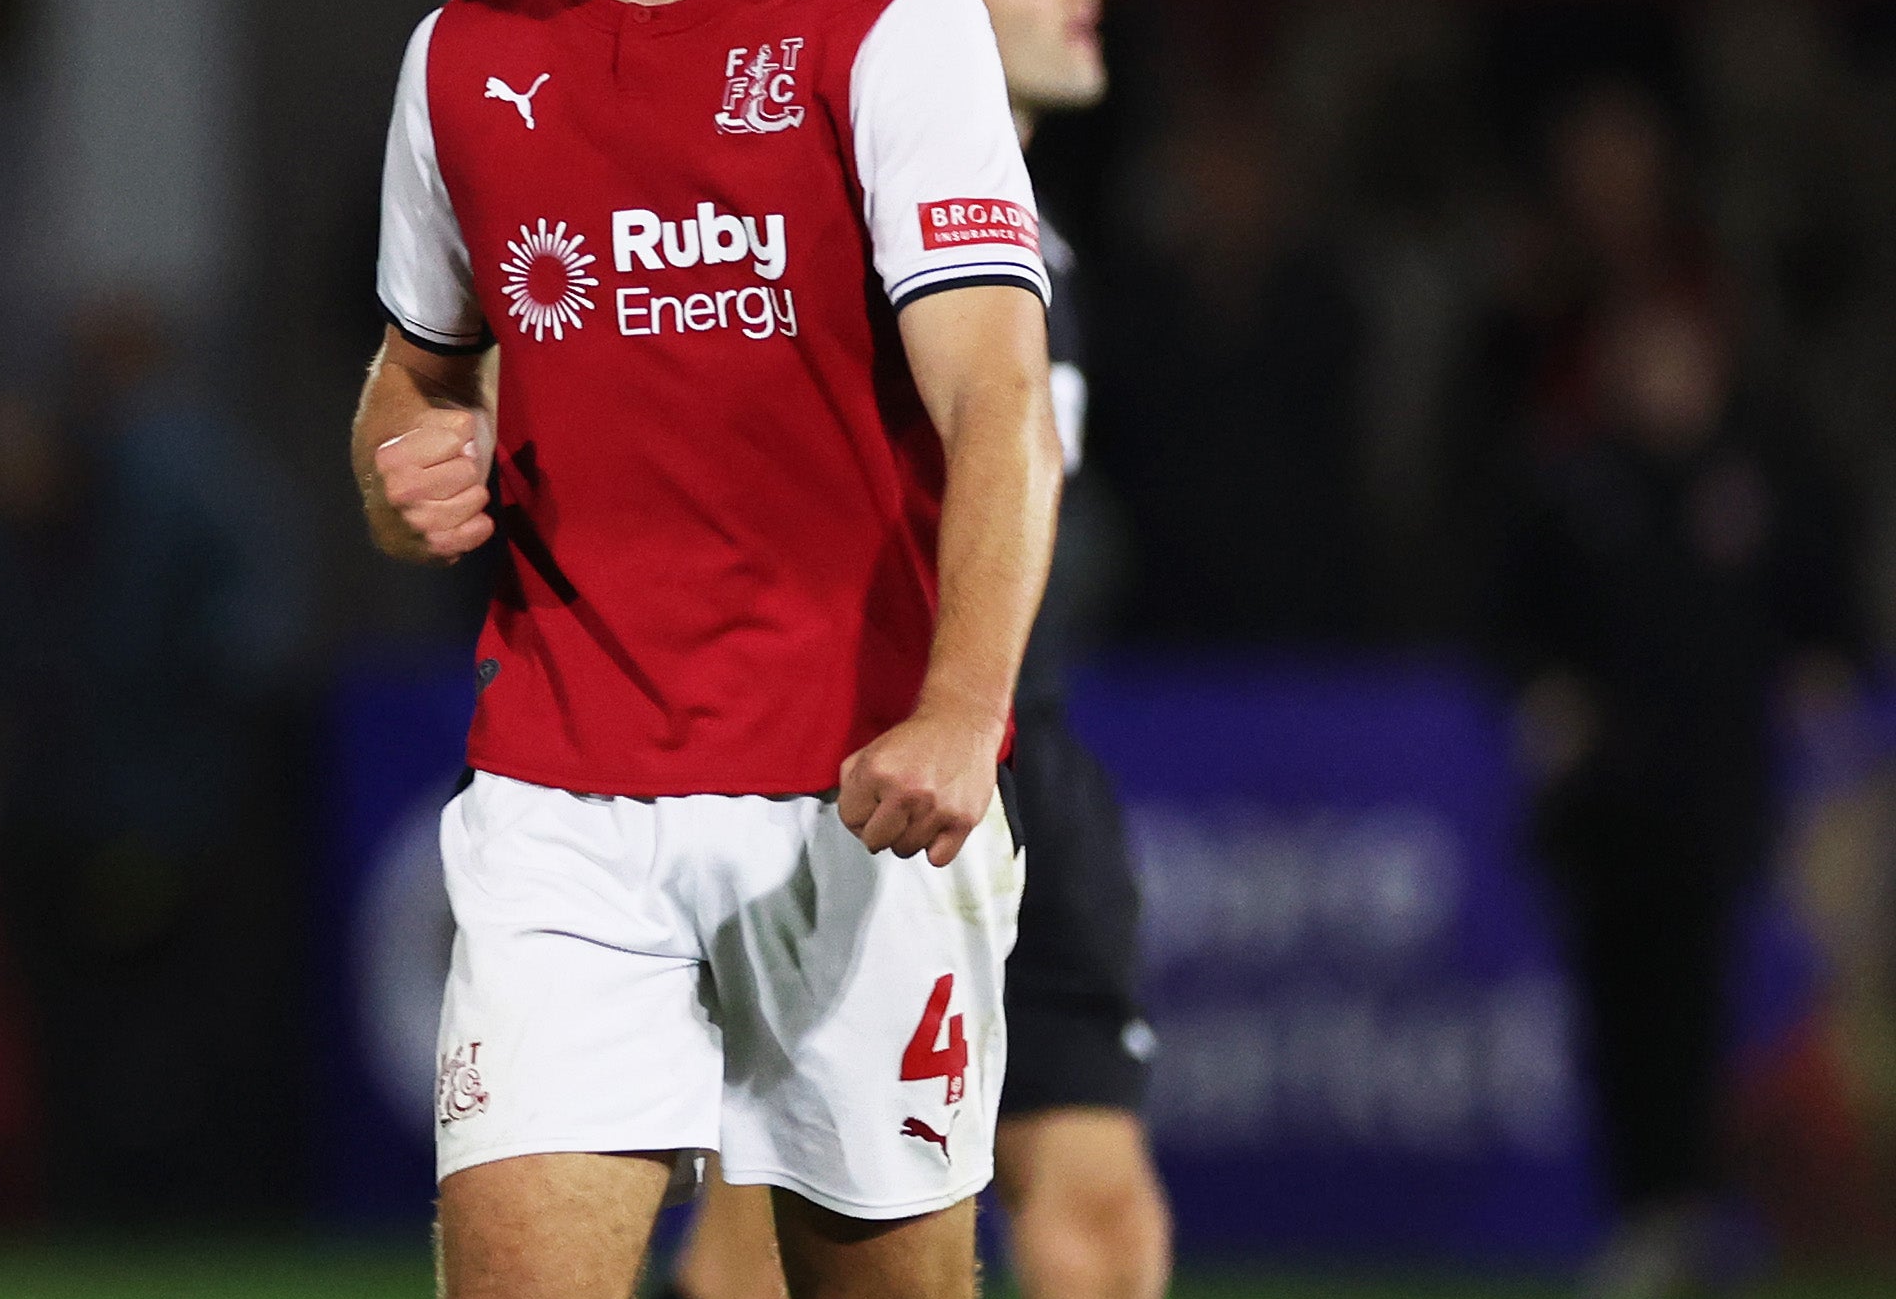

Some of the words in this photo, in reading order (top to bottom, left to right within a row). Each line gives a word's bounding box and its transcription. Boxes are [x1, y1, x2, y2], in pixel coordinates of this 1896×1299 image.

[611, 201, 788, 281] Ruby
[933, 228, 1017, 243] INSURANCE
[617, 284, 798, 340] Energy
[898, 972, 969, 1106] 4
